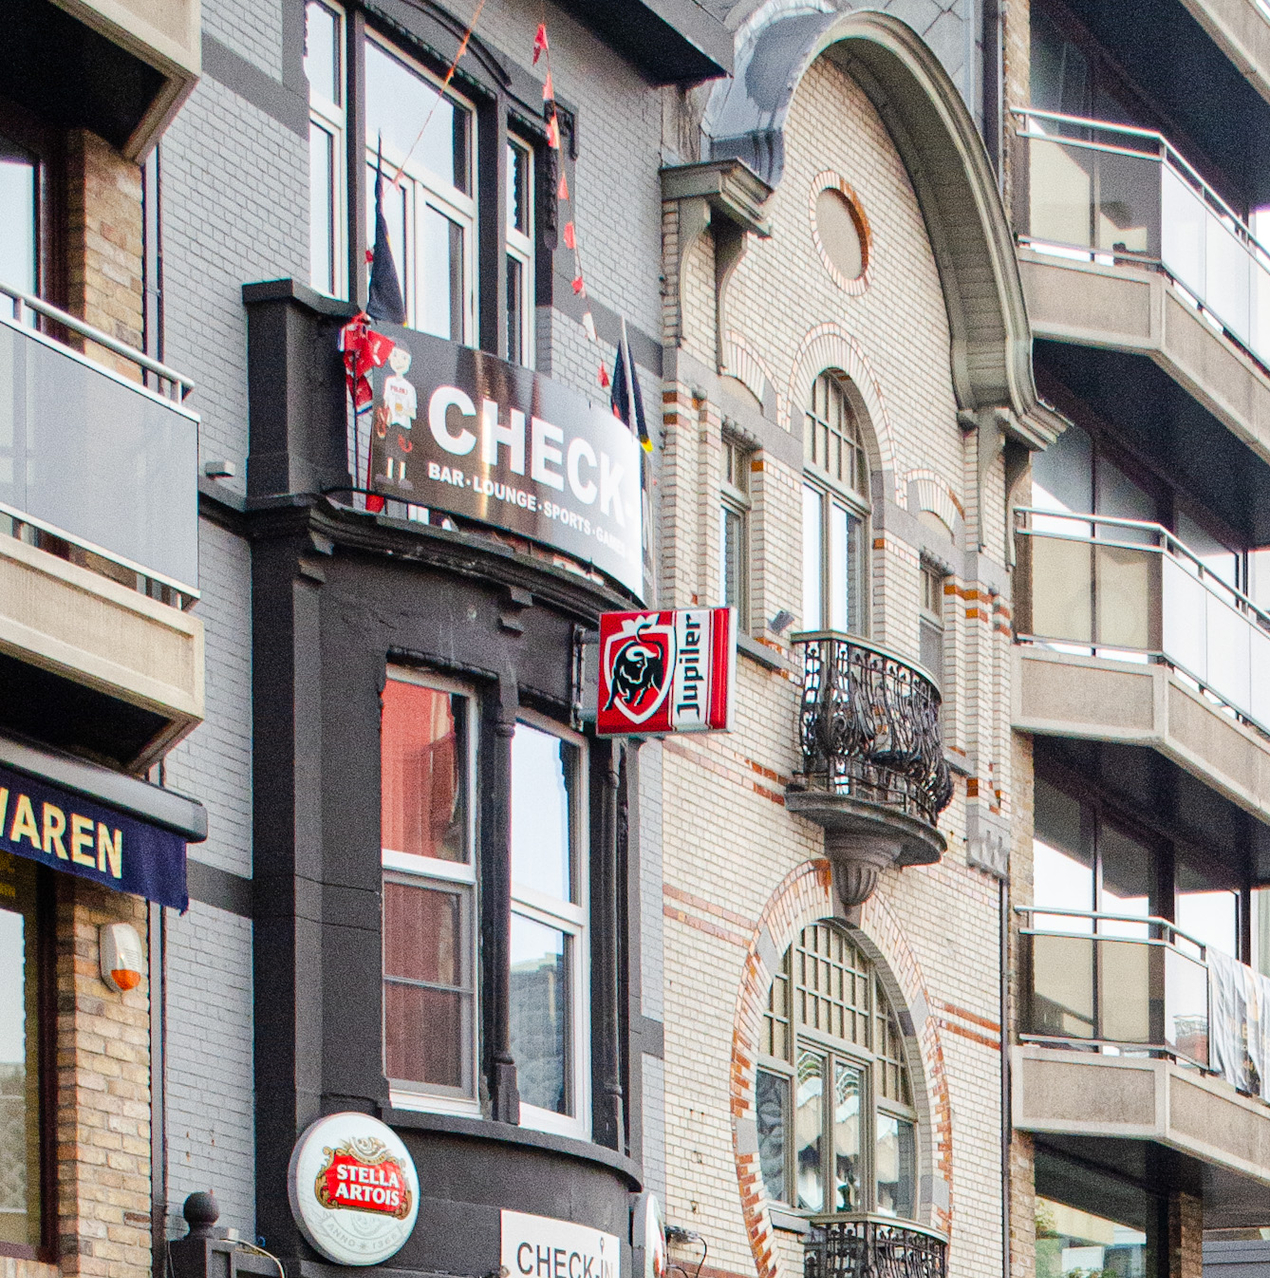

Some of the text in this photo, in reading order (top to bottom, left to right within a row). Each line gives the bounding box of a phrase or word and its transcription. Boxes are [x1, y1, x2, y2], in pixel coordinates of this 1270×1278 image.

[428, 461, 465, 488] BAR
[473, 477, 537, 513] LOUNGE
[543, 499, 592, 536] SPORTS
[676, 613, 704, 720] Jupiler
[336, 1163, 399, 1188] STELLA
[335, 1183, 400, 1207] ARTOIS
[326, 1222, 357, 1247] ANNO
